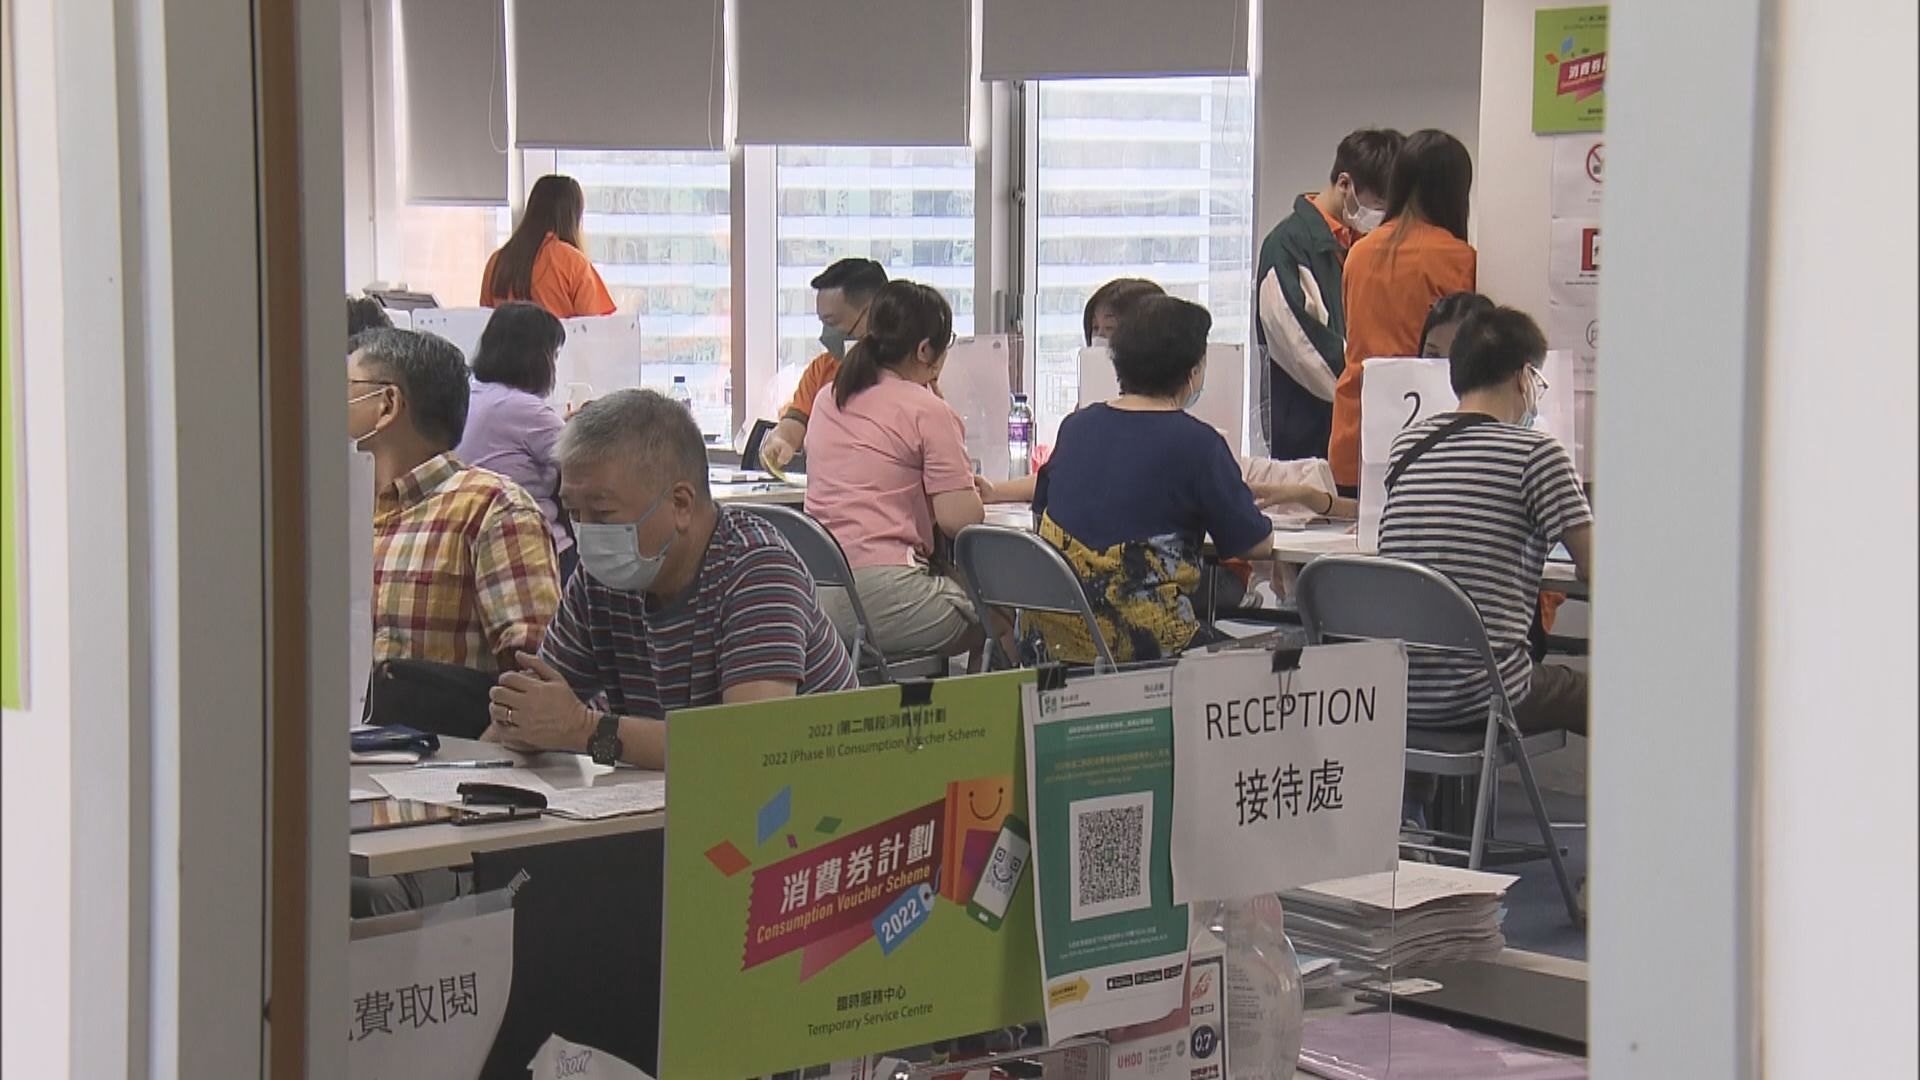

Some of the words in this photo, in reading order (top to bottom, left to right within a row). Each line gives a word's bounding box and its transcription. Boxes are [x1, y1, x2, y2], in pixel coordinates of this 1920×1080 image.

[1568, 56, 1607, 81] 消費券
[1402, 391, 1421, 429] 2
[808, 723, 833, 739] 2022
[1205, 686, 1377, 741] RECEPTION
[762, 752, 788, 767] 2022
[790, 749, 824, 766] (Phase
[837, 735, 904, 758] Consumption
[947, 727, 986, 743] Scheme
[1234, 759, 1345, 827] 接待處
[780, 819, 935, 914] 消費券計劃
[757, 903, 833, 944] Consumption
[837, 883, 883, 912] Voucher
[885, 864, 930, 894] Scheme
[881, 897, 921, 944] 2022
[348, 971, 479, 1042] 費取閱
[836, 984, 907, 1012] 臨時服務中心
[807, 1014, 862, 1037] Temporary
[864, 1007, 899, 1025] Service
[900, 1002, 933, 1018] Centre
[1117, 1052, 1143, 1069] UHOO
[1195, 1034, 1212, 1053] 0.7
